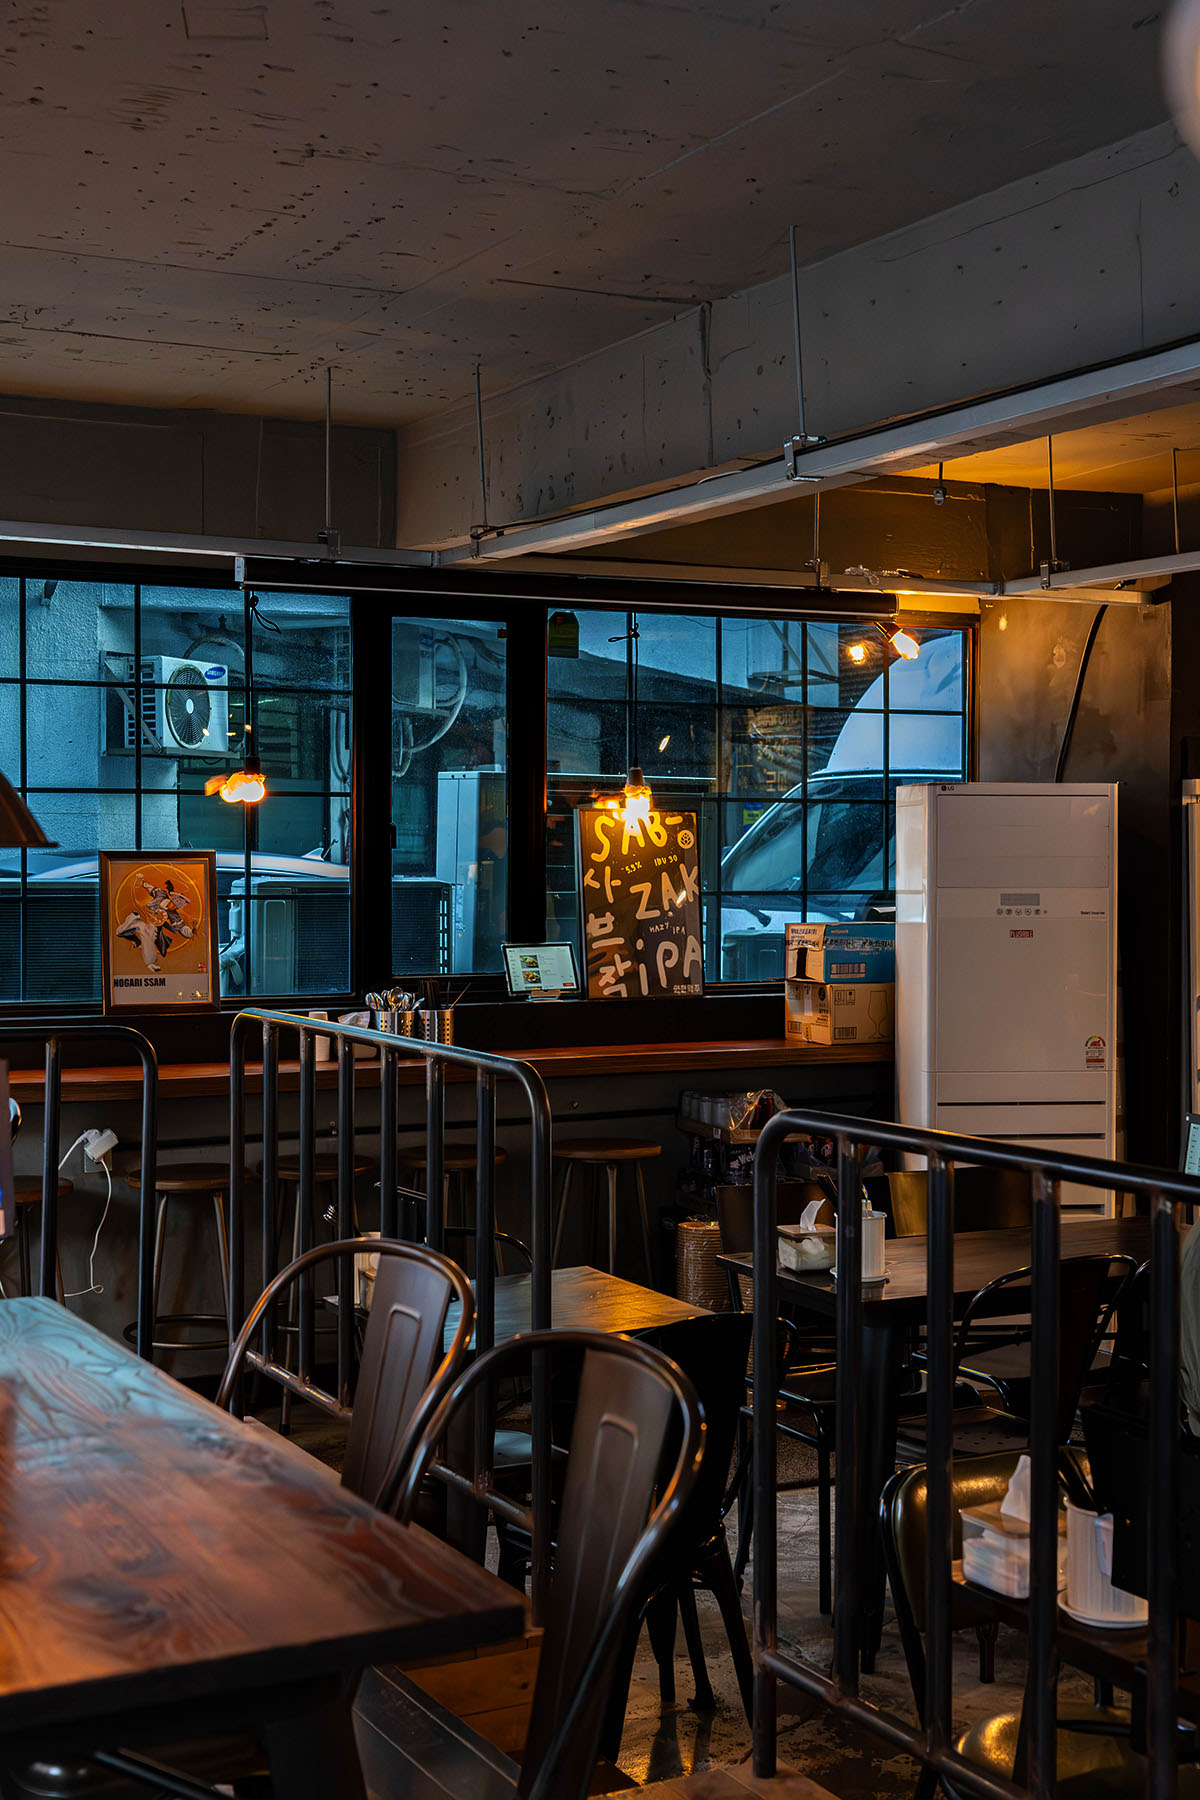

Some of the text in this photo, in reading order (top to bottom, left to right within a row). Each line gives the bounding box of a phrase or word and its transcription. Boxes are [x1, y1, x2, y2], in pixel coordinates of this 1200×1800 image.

[629, 863, 700, 920] ZAK
[649, 921, 686, 935] HAZY IPA
[113, 978, 166, 987] NOGARI SSAM
